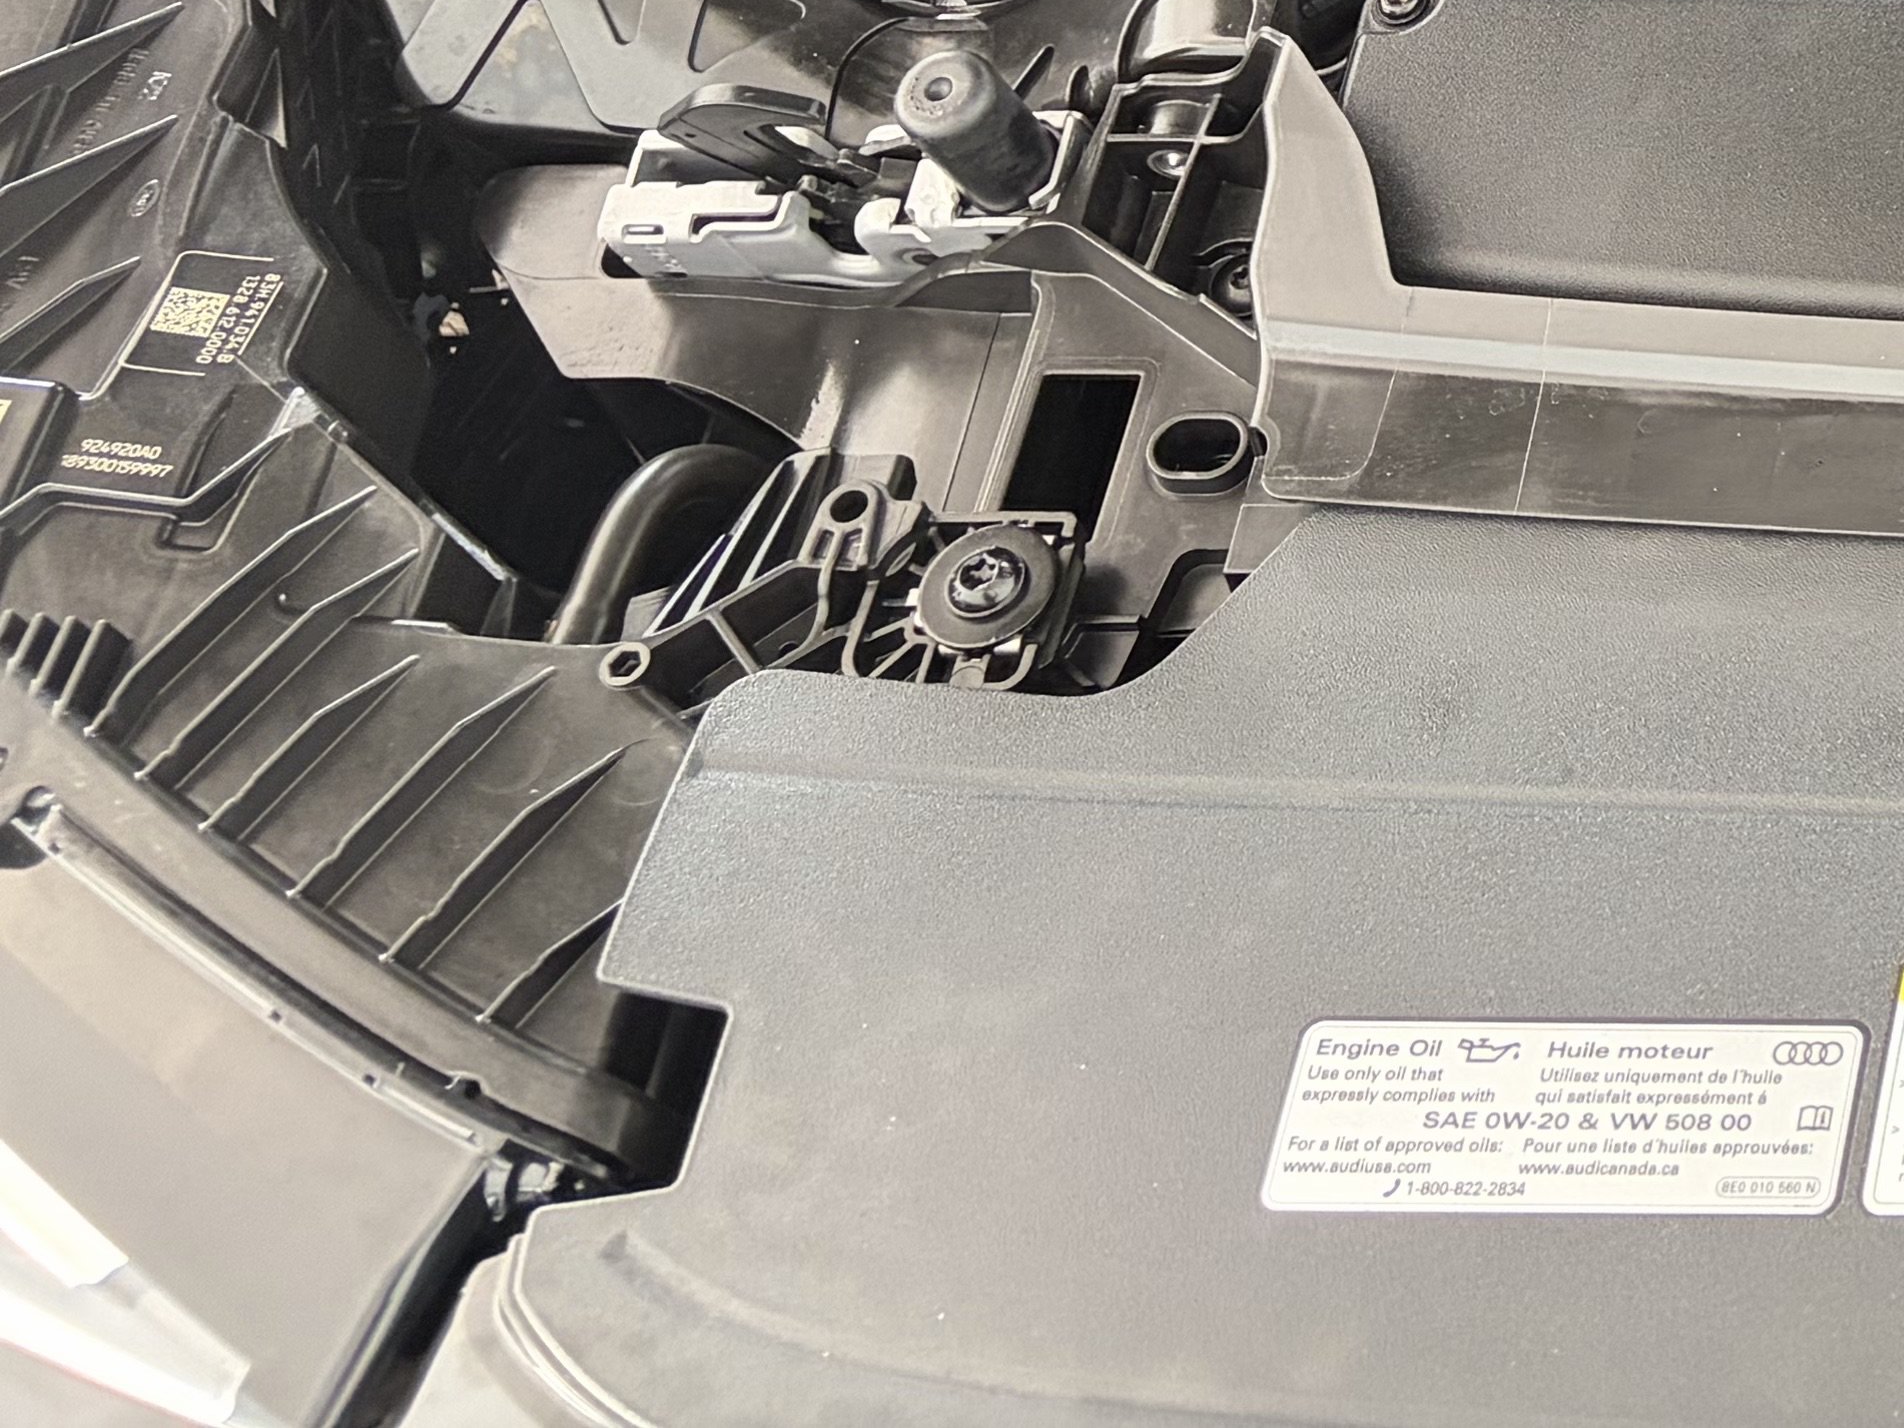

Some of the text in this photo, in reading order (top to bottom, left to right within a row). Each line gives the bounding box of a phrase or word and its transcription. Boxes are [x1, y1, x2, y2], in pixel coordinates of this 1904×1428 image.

[1316, 1038, 1443, 1059] Engine Oil
[1547, 1041, 1713, 1060] Huile moteur
[1307, 1065, 1443, 1083] Use only oil that
[1540, 1067, 1600, 1084] Utilisez
[1603, 1069, 1703, 1088] uniquement
[1707, 1069, 1728, 1084] de
[1302, 1087, 1495, 1104] expressly complies with
[1535, 1091, 1563, 1107] qui
[1567, 1090, 1632, 1105] satisfait
[1636, 1089, 1752, 1108] expressément
[1423, 1111, 1752, 1132] SAE 0W-20 & VW 508 00
[1288, 1136, 1504, 1155] For a list of approved oils:
[1522, 1138, 1561, 1154] Pour
[1567, 1141, 1597, 1154] une
[1603, 1138, 1637, 1154] liste
[1712, 1139, 1814, 1158] approuvées:
[1283, 1158, 1432, 1174] www.audiusa.com
[1518, 1160, 1680, 1176] www.audicanada.ca
[1407, 1181, 1526, 1197] 1-800-822-2834
[1749, 1181, 1774, 1194] 010
[1778, 1181, 1801, 1194] 560
[1806, 1181, 1817, 1194] N
